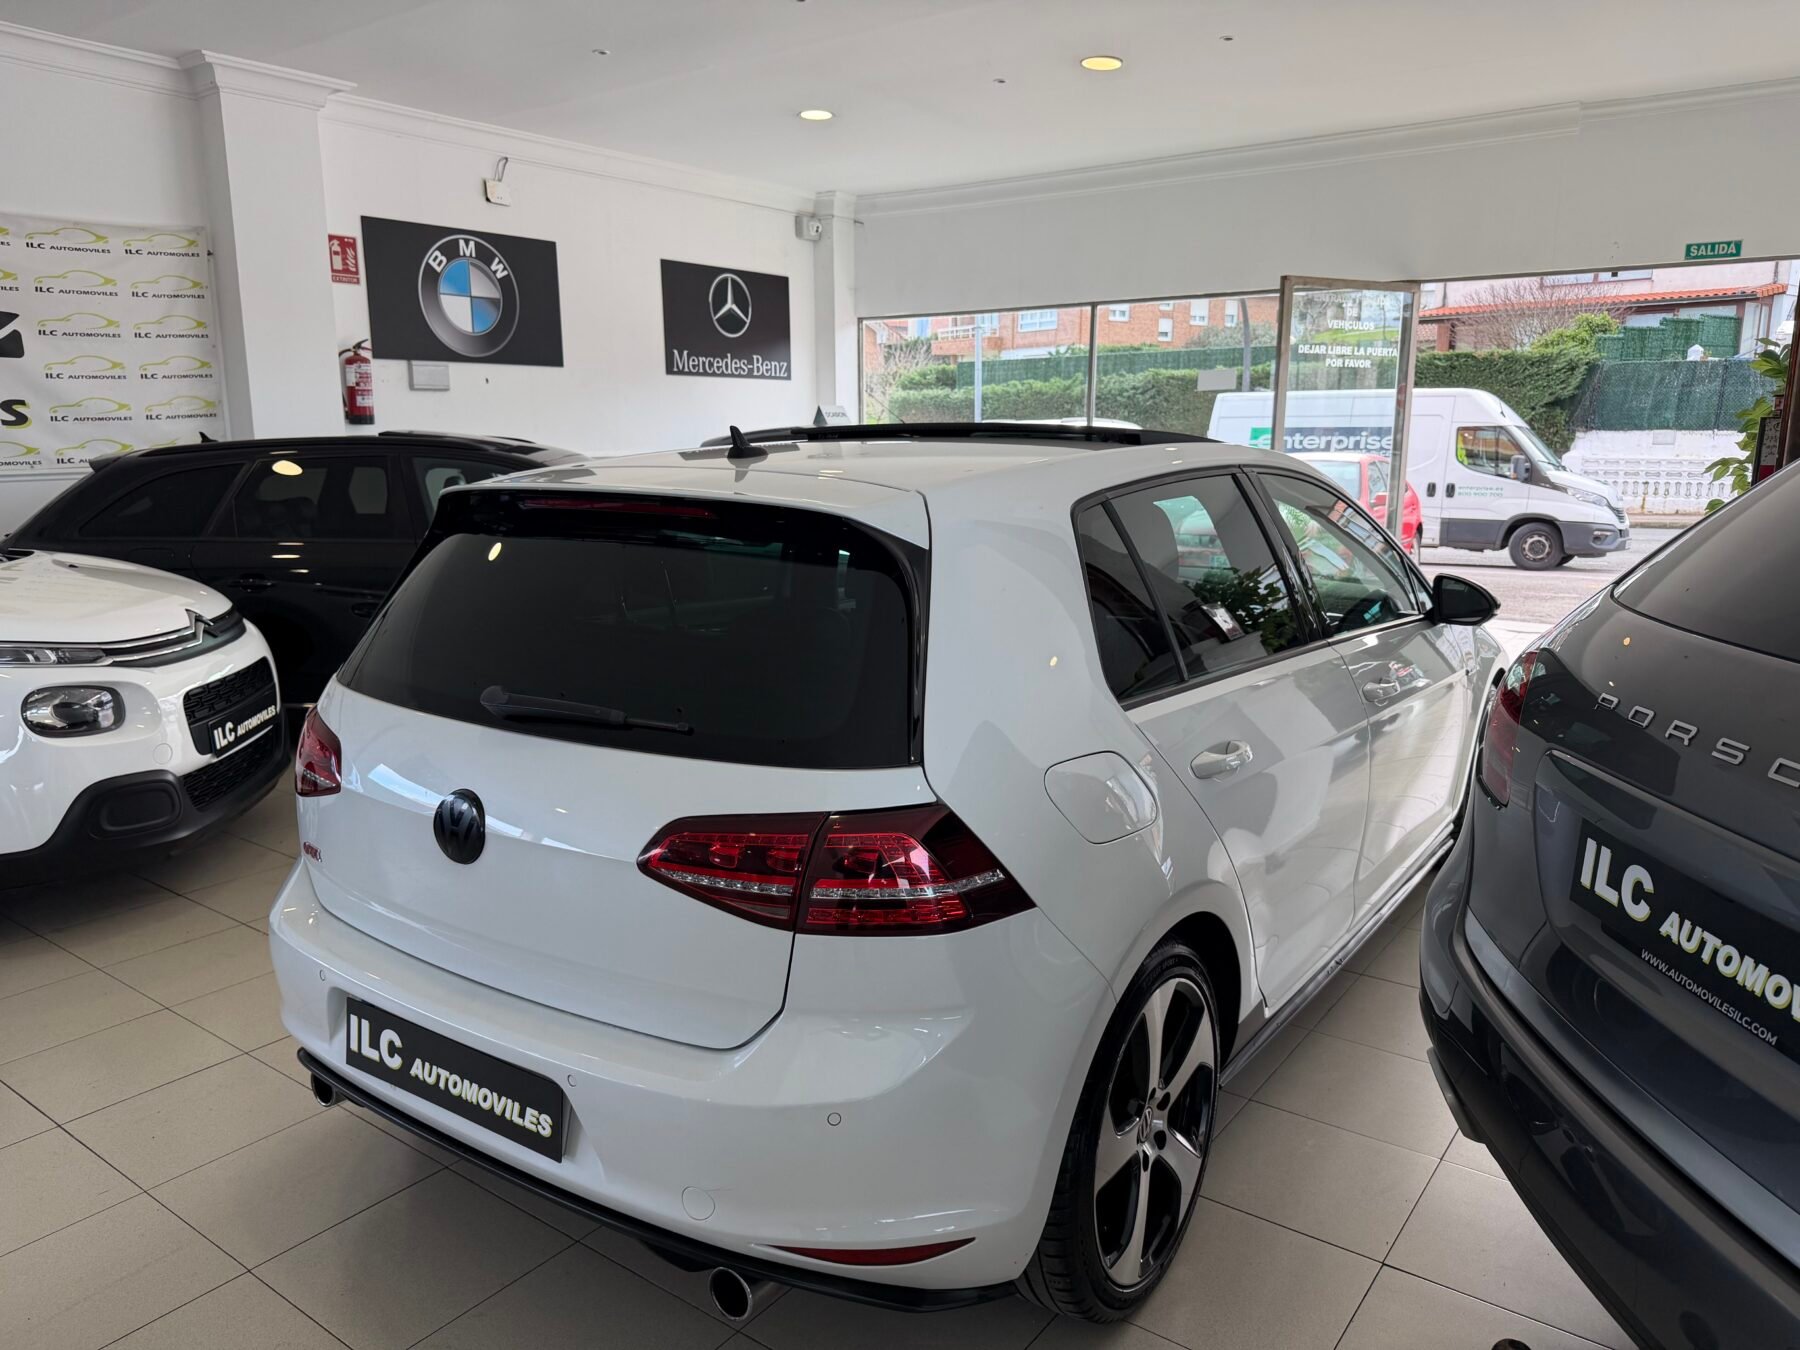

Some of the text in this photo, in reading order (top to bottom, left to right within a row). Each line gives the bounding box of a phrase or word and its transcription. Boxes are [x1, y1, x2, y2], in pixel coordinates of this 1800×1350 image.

[49, 245, 111, 254] AUTOMOVILES
[428, 239, 508, 280] BMW
[35, 286, 118, 297] ILC AUTOMOVILES
[672, 349, 788, 377] Mercedes-Benz
[1298, 344, 1398, 357] DEJAR LIBRE LA PUERTA
[1325, 358, 1372, 368] POR FAVOR
[213, 705, 276, 750] ILC AUTOMOVILES
[1580, 837, 1655, 922] ILC
[1641, 948, 1779, 1046] WWW.AUTOMOVILESILC.COM
[350, 1013, 553, 1138] ILC AUTOMOVILES
